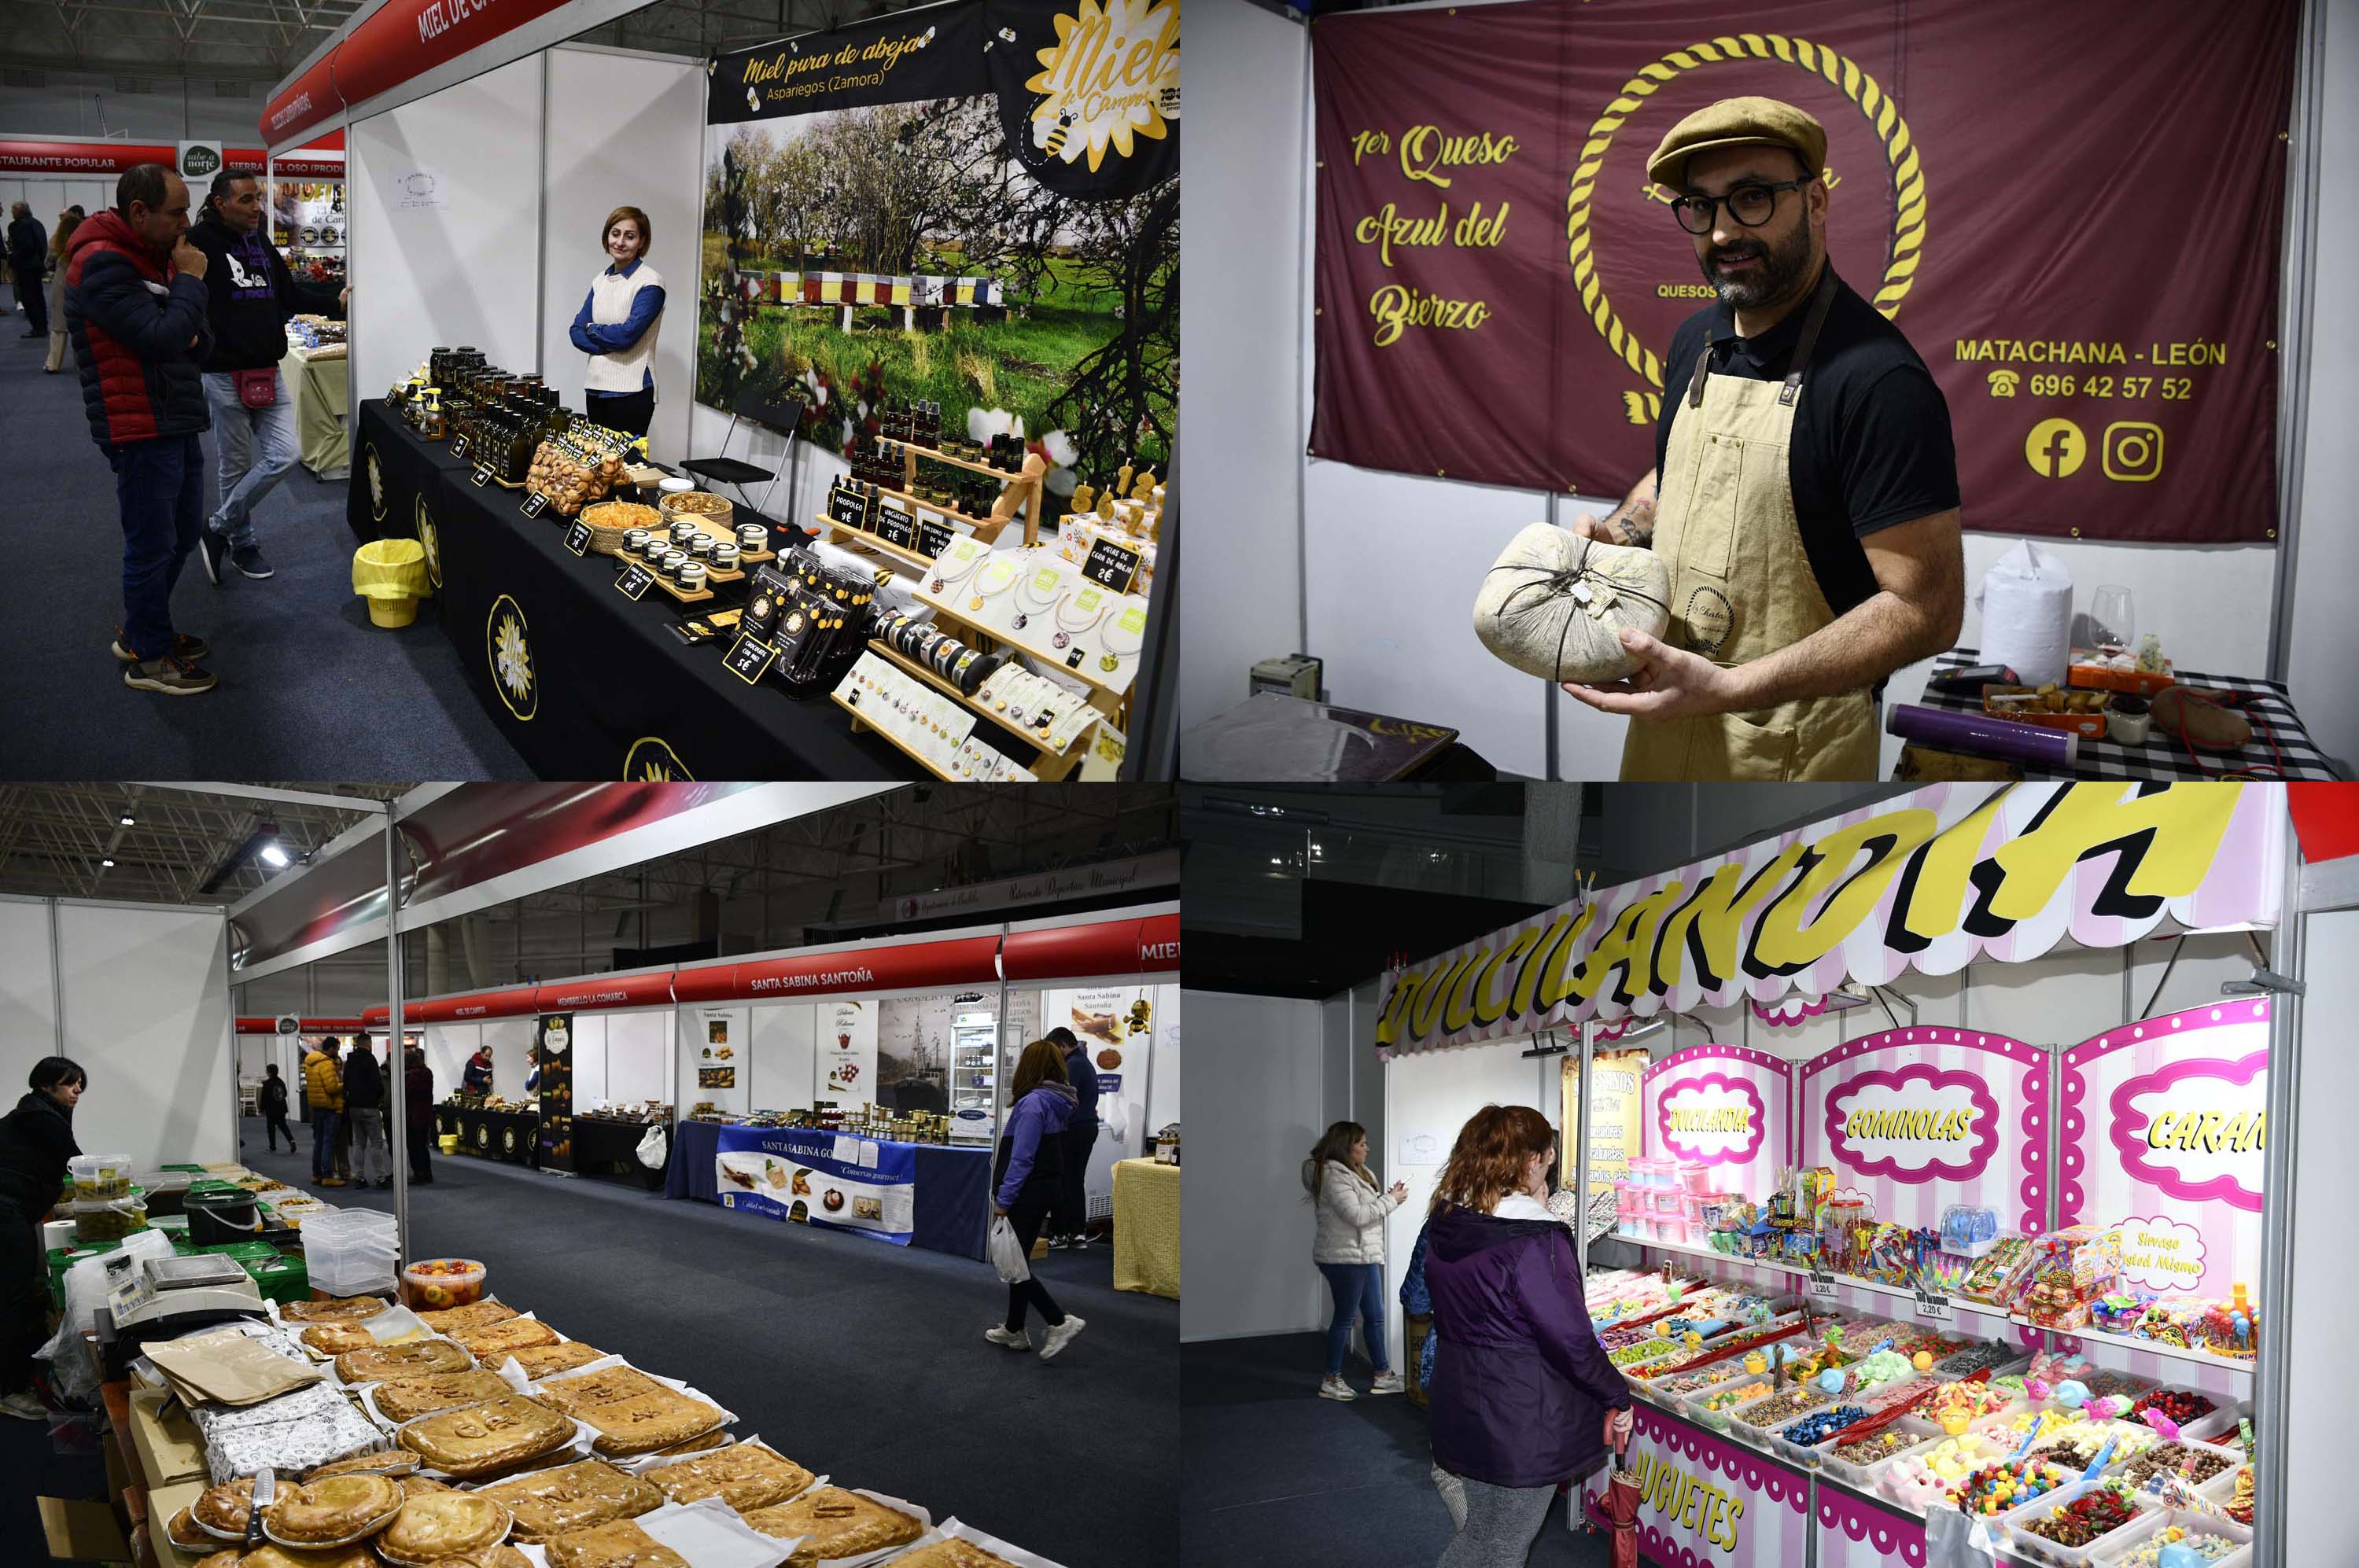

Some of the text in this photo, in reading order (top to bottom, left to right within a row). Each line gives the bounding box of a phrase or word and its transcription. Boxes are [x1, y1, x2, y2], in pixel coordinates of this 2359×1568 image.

[418, 2, 450, 43] MIEL
[1049, 3, 1180, 99] Miel
[743, 53, 786, 84] Miel
[784, 53, 832, 83] pura
[834, 43, 861, 65] de
[766, 70, 884, 101] Aspariegos (Zamora)
[1084, 90, 1150, 122] Campos
[65, 158, 115, 167] POPULAR
[1351, 125, 1520, 189] 1er Queso
[229, 162, 264, 171] SIERRA
[1355, 201, 1509, 267] Azul del
[1657, 285, 1718, 298] QUESOS
[1369, 285, 1491, 347] Bierzo
[1955, 340, 2126, 364] MATACHANA
[2151, 337, 2226, 366] LEÓN
[2030, 374, 2192, 400] 696 42 57 52
[835, 496, 863, 511] PROPOLEO
[841, 512, 852, 523] 9€
[886, 519, 912, 534] PROPOLEO
[888, 529, 898, 541] 7€
[923, 524, 942, 536] BALSAMO
[1103, 545, 1130, 561] VELAS DE
[1091, 550, 1133, 575] CERA DE ABEJA
[1097, 568, 1115, 583] 2€
[625, 581, 636, 591] 6€
[745, 640, 767, 657] CHOCOLATE
[737, 658, 752, 671] 5€
[1376, 782, 2243, 1047] DULCILANDIA
[751, 966, 874, 991] SANTA SABINA SANTOÑA
[557, 992, 628, 1007] MEMBRILLO LA COMARCA
[1846, 1109, 1974, 1142] GOMINOLAS
[2154, 1256, 2201, 1275] Mismo
[1815, 1284, 1826, 1293] 2,20
[1922, 1305, 1936, 1314] 2,20
